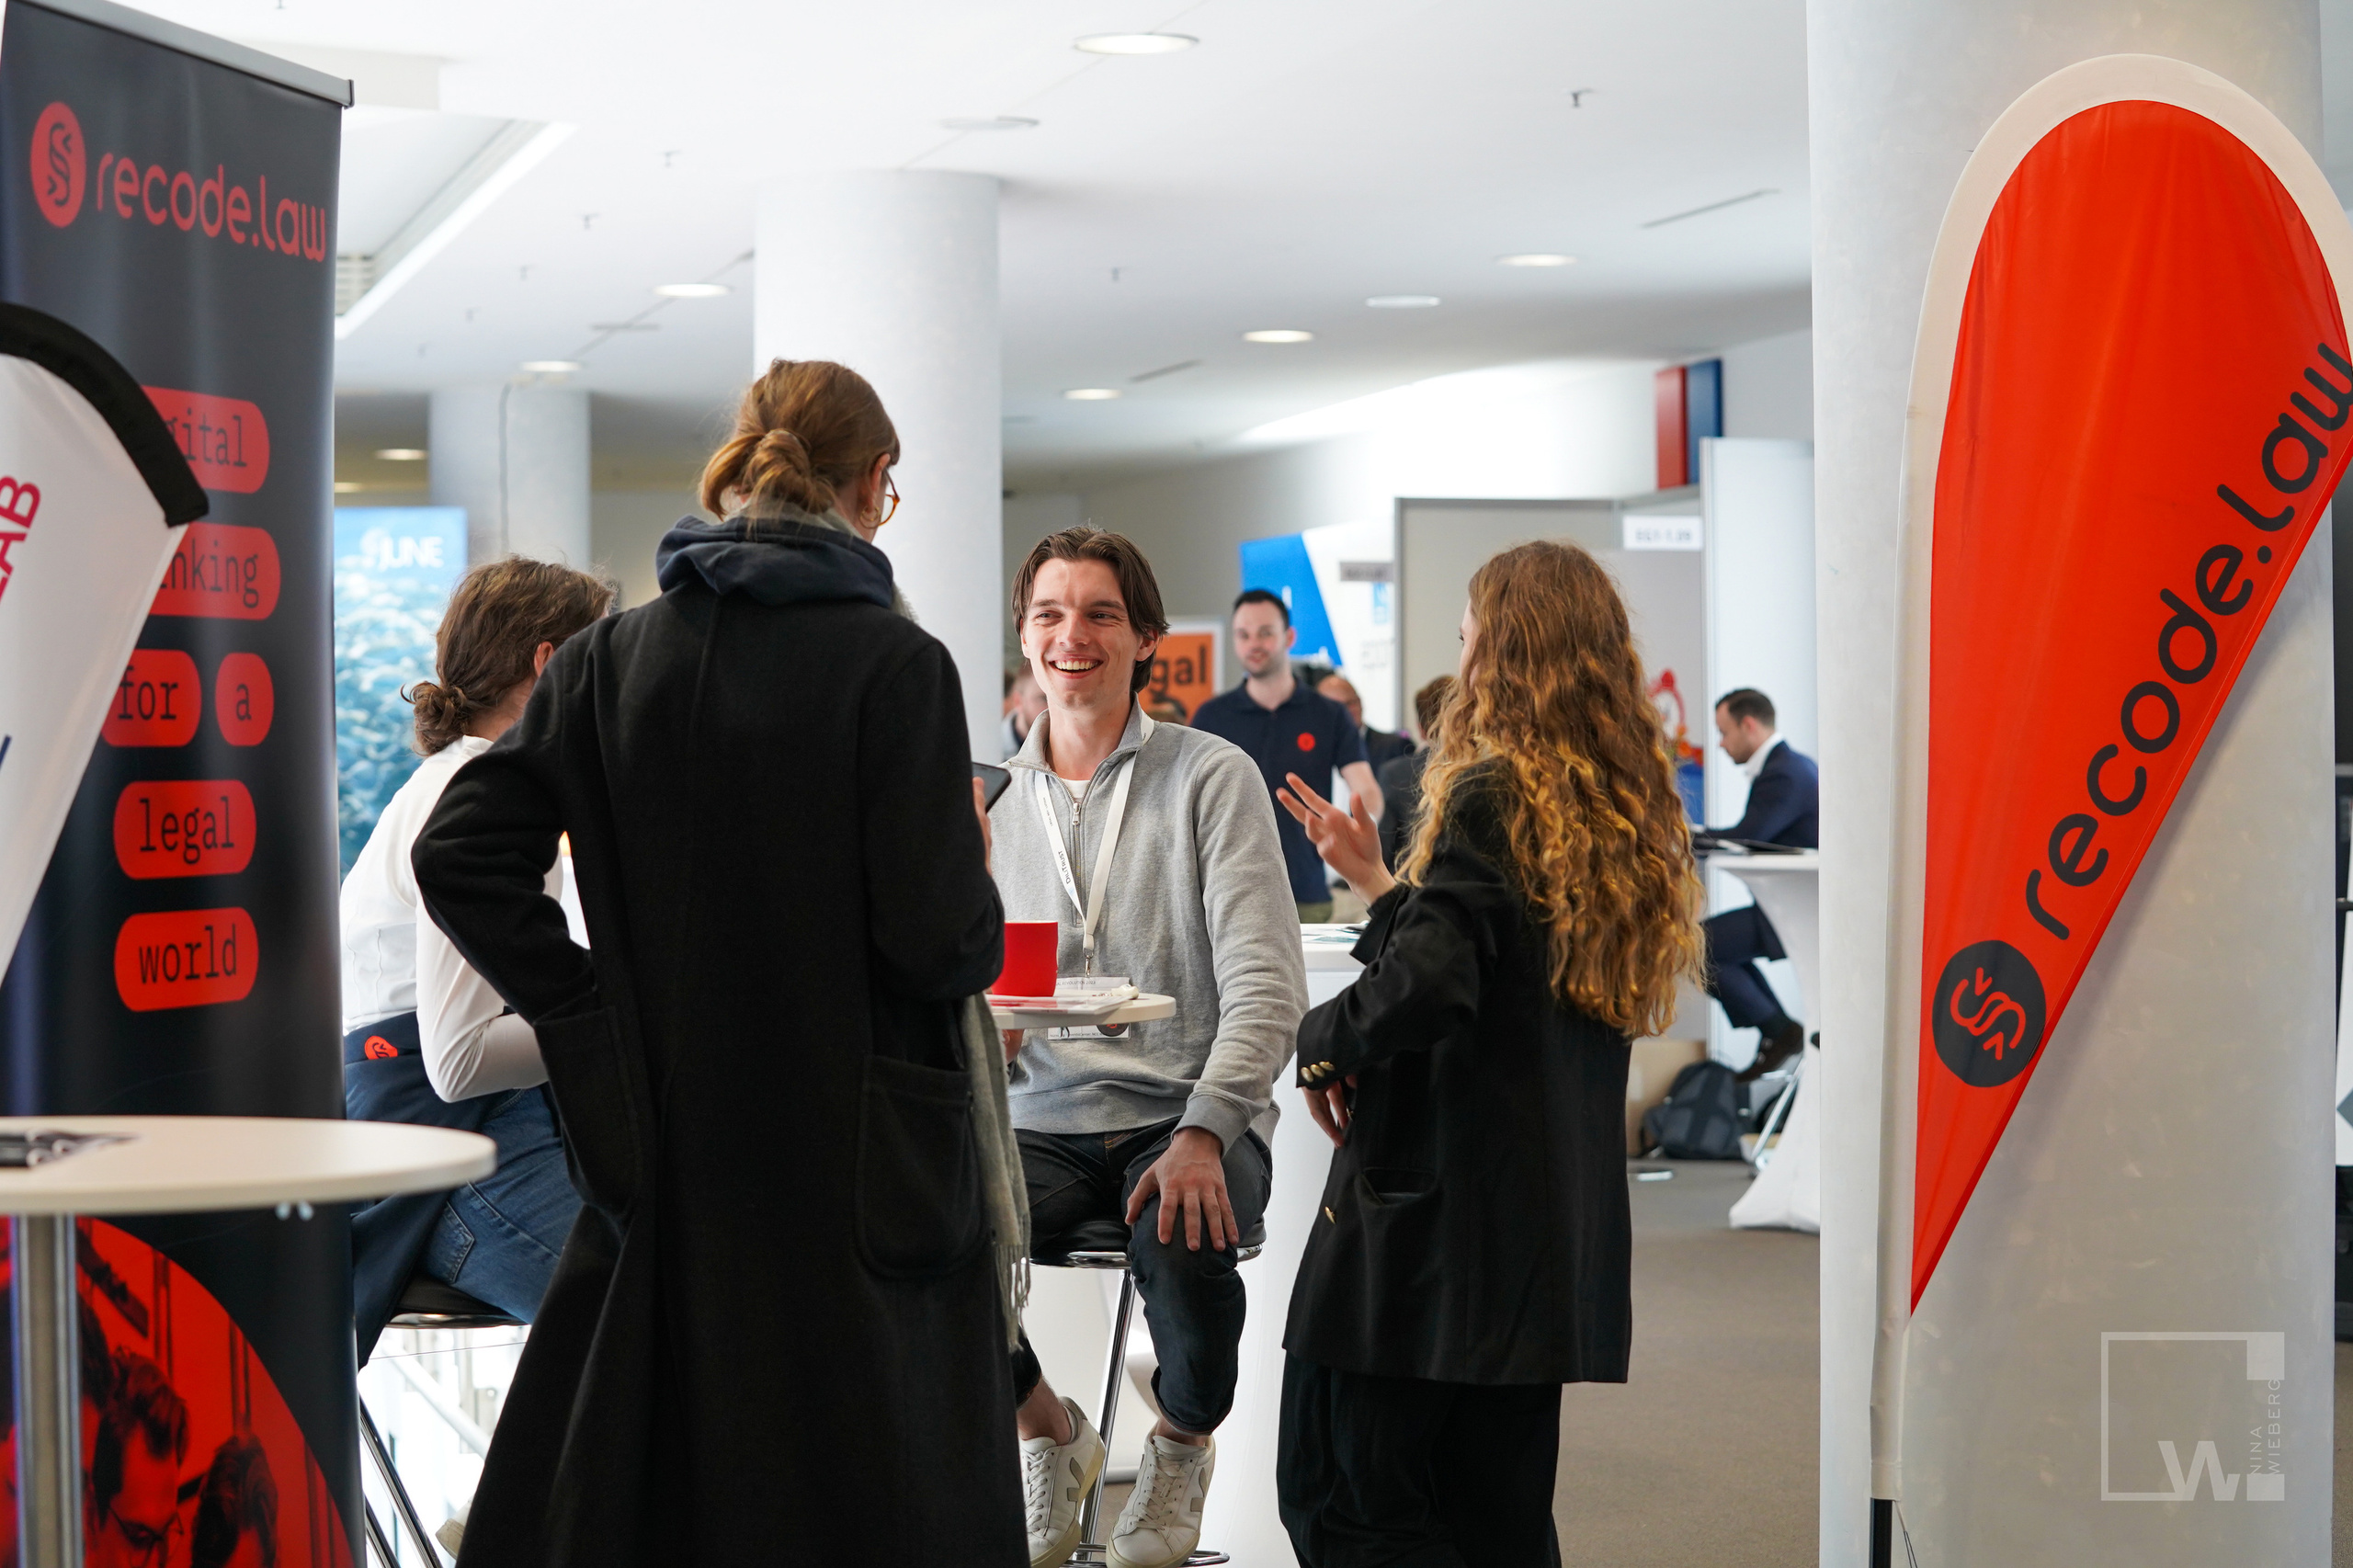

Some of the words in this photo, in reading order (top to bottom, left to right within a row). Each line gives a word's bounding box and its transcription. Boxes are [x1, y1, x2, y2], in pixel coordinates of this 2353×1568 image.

[97, 153, 325, 262] recode.law
[165, 407, 247, 467] ital
[160, 537, 259, 608] nking
[1151, 644, 1207, 697] gal
[2026, 342, 2353, 940] recode.law
[118, 665, 179, 722] for
[235, 682, 252, 722] a
[139, 796, 235, 865] legal
[139, 923, 237, 985] world
